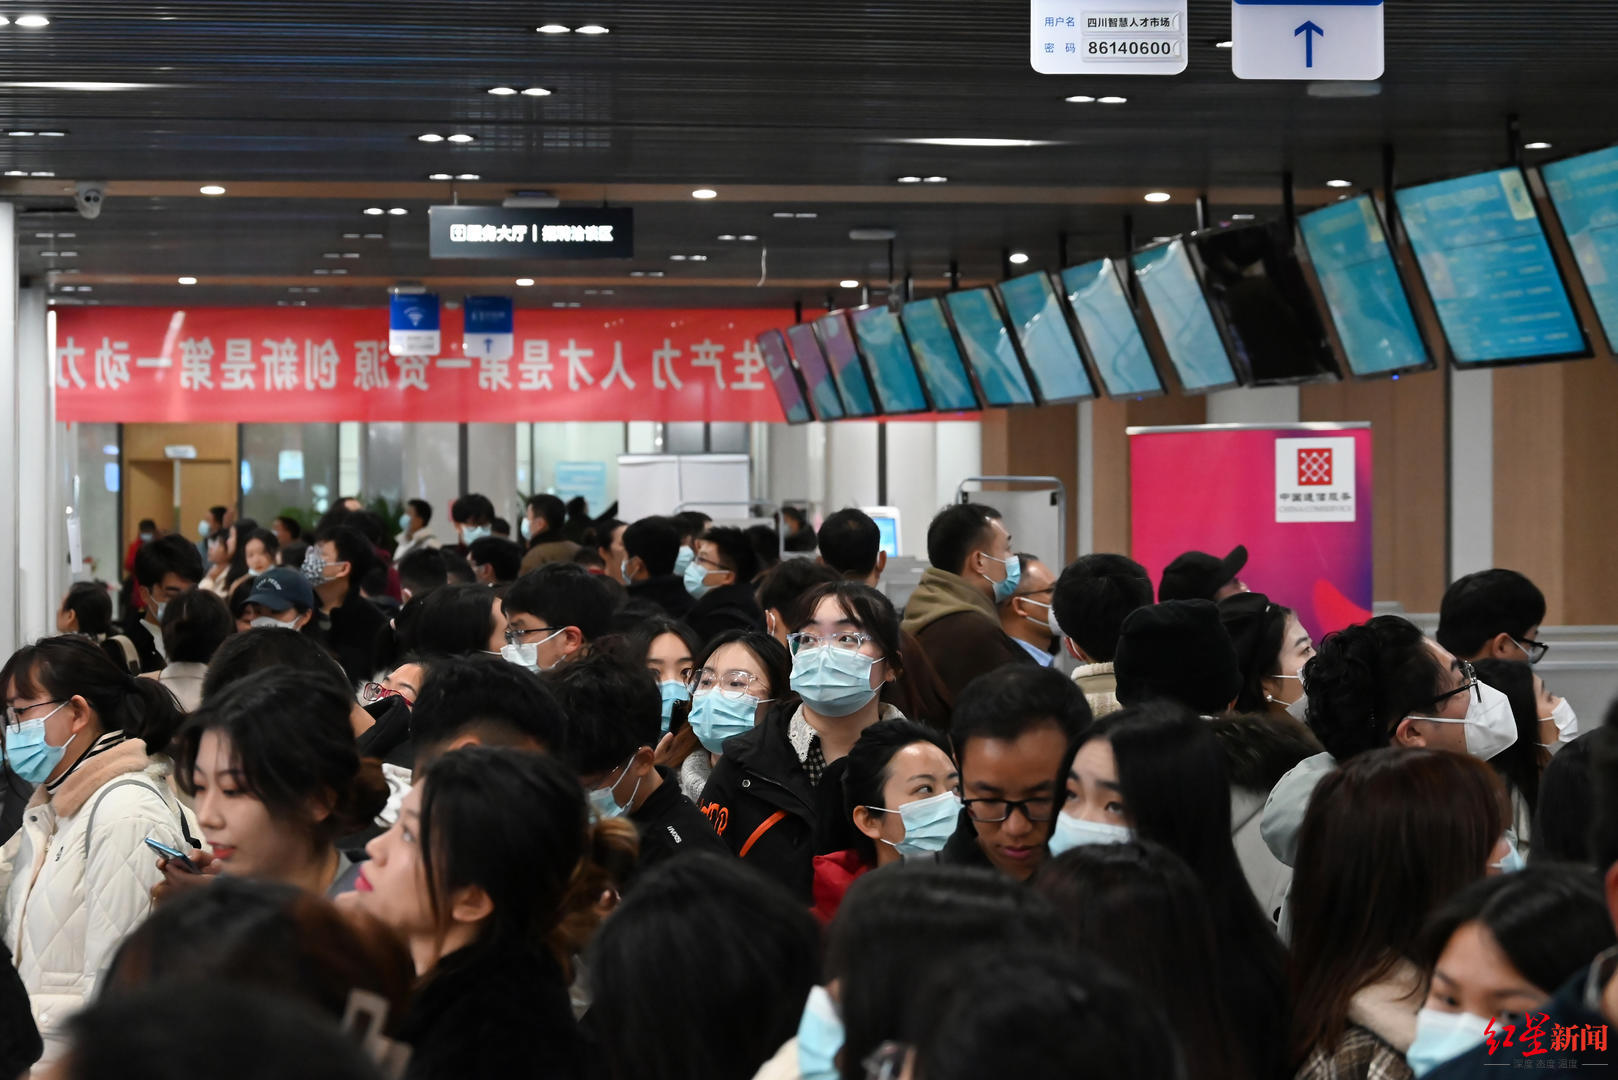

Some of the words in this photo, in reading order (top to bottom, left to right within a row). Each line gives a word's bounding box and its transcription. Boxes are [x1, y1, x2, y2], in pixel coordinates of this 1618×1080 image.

[1044, 16, 1076, 28] 用户名
[1087, 17, 1171, 28] 四川智慧人才市场
[1087, 41, 1172, 55] 86140600
